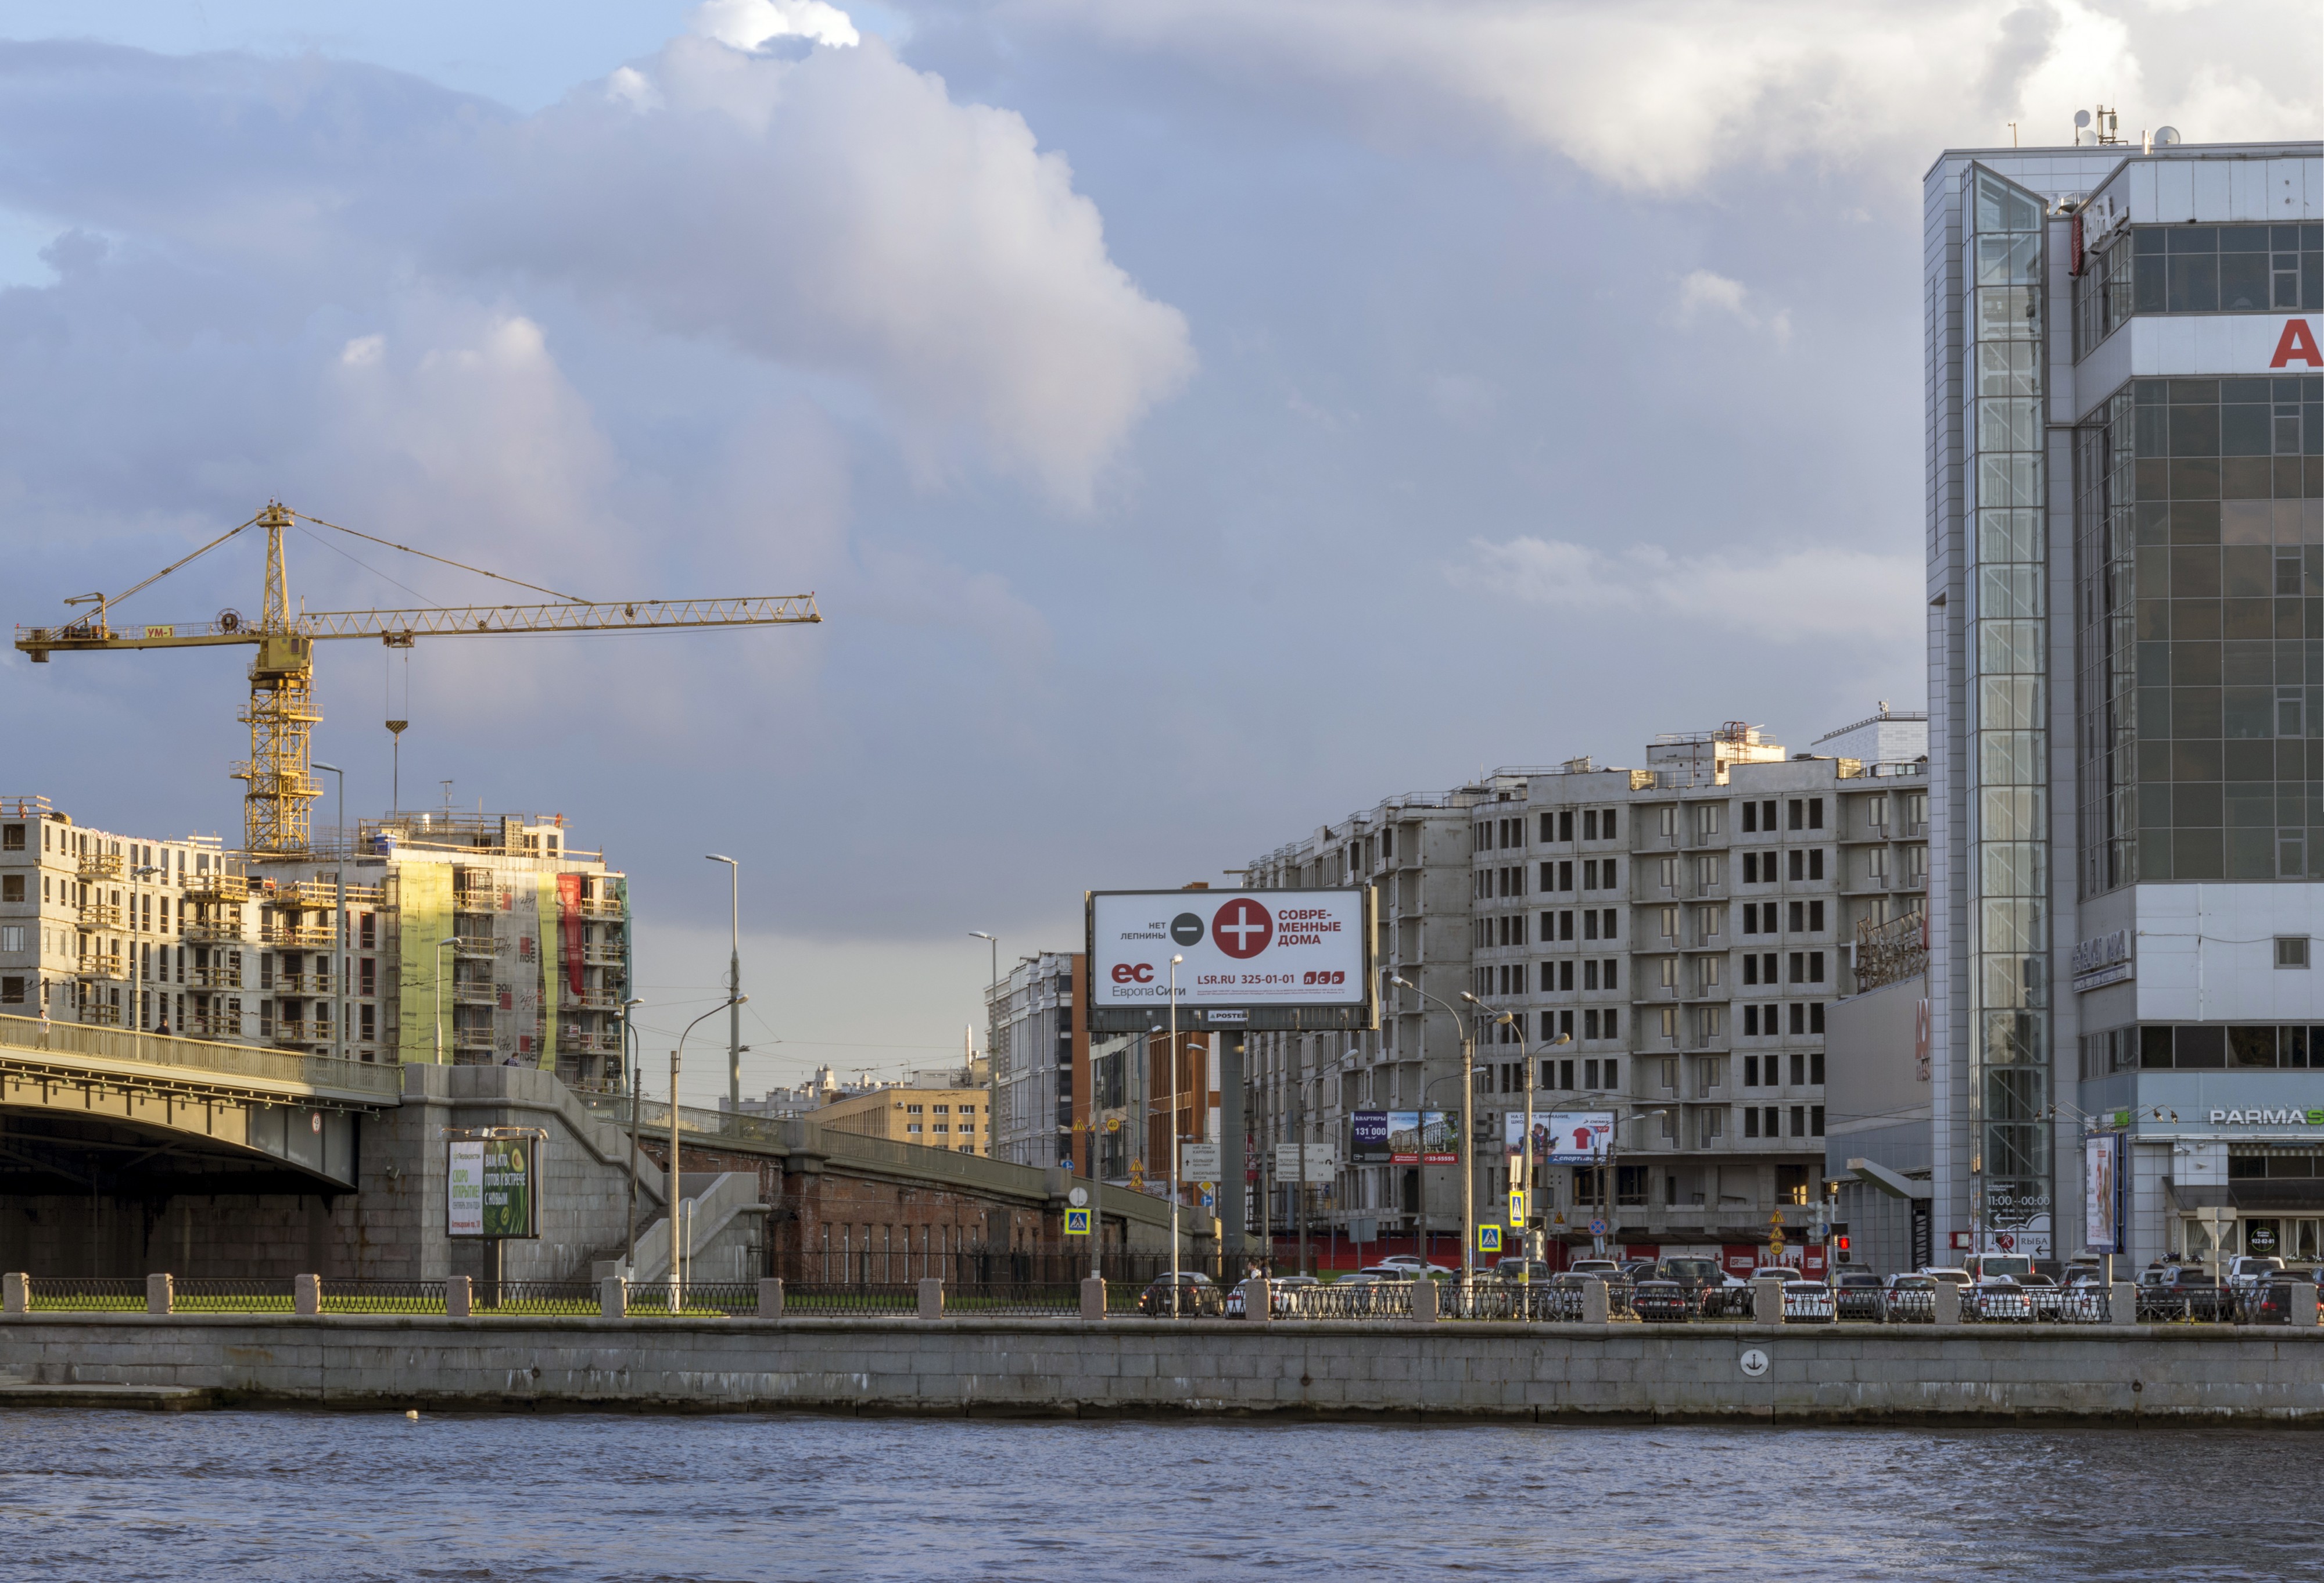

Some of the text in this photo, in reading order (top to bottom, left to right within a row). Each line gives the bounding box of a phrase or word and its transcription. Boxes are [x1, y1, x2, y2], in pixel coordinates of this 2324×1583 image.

[2269, 319, 2323, 368] A
[148, 628, 173, 638] УМ-1
[1278, 909, 1332, 920] СОВРЕ-
[1279, 922, 1341, 932] МЕННЫЕ
[1278, 934, 1321, 947] ДОМА
[1197, 974, 1294, 984] LSR.RU 325-01-01
[1113, 986, 1154, 998] Европа
[485, 1154, 508, 1169] ВАМ, КТО
[453, 1169, 468, 1183] СКОРО
[485, 1172, 526, 1186] ГОТОВ К ВСТРЕЧЕ
[452, 1185, 480, 1198] ОТКРЫТИЕ!
[485, 1192, 508, 1205] С НОВЫМ
